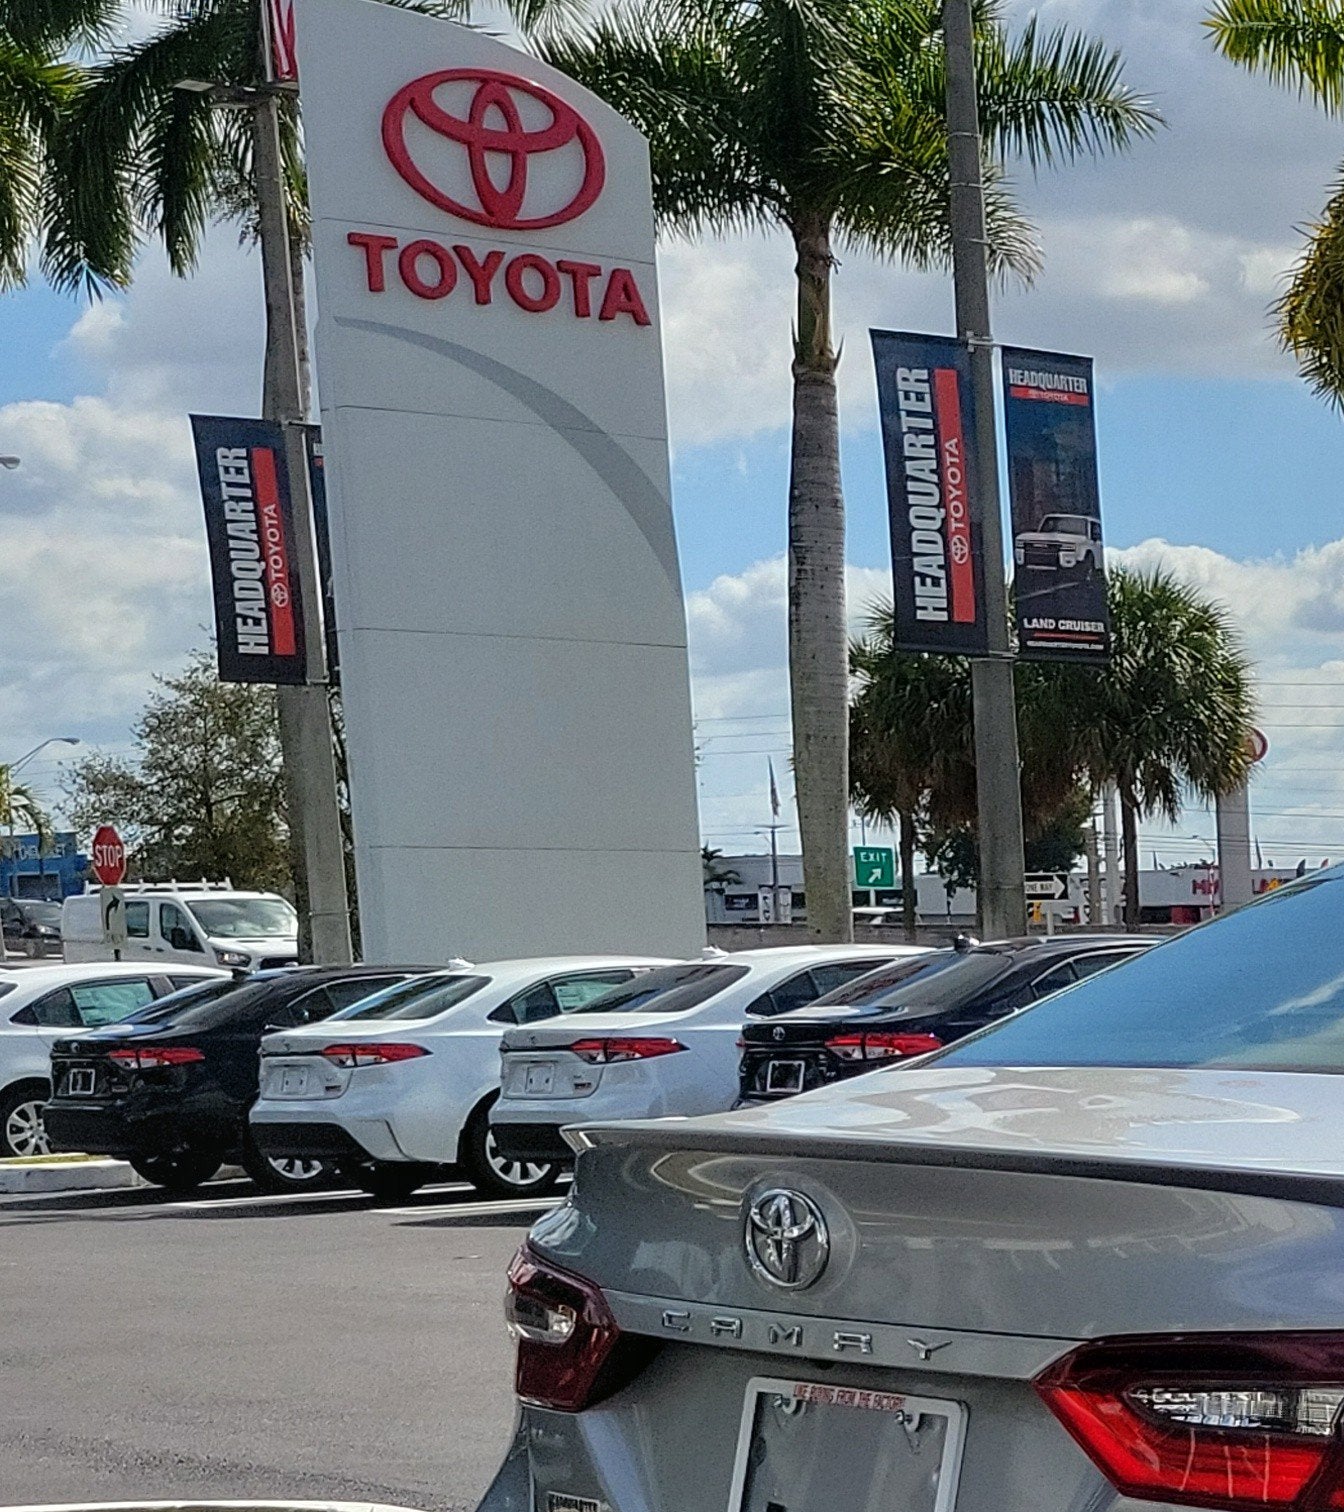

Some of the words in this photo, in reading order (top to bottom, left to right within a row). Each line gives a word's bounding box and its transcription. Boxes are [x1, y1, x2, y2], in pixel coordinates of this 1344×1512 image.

[347, 232, 652, 326] TOYOTA
[1008, 368, 1088, 394] HEADQUARTER
[896, 366, 949, 622] HEADQUARTER
[944, 436, 967, 532] TOYOTA
[216, 446, 270, 656] HEADQUARTER
[263, 503, 286, 581] TOYOTA
[1023, 617, 1056, 629] LAND
[1058, 619, 1105, 633] CRUISER
[95, 844, 122, 868] STOP
[860, 851, 887, 862] EXIT
[662, 1309, 953, 1361] CAMRY
